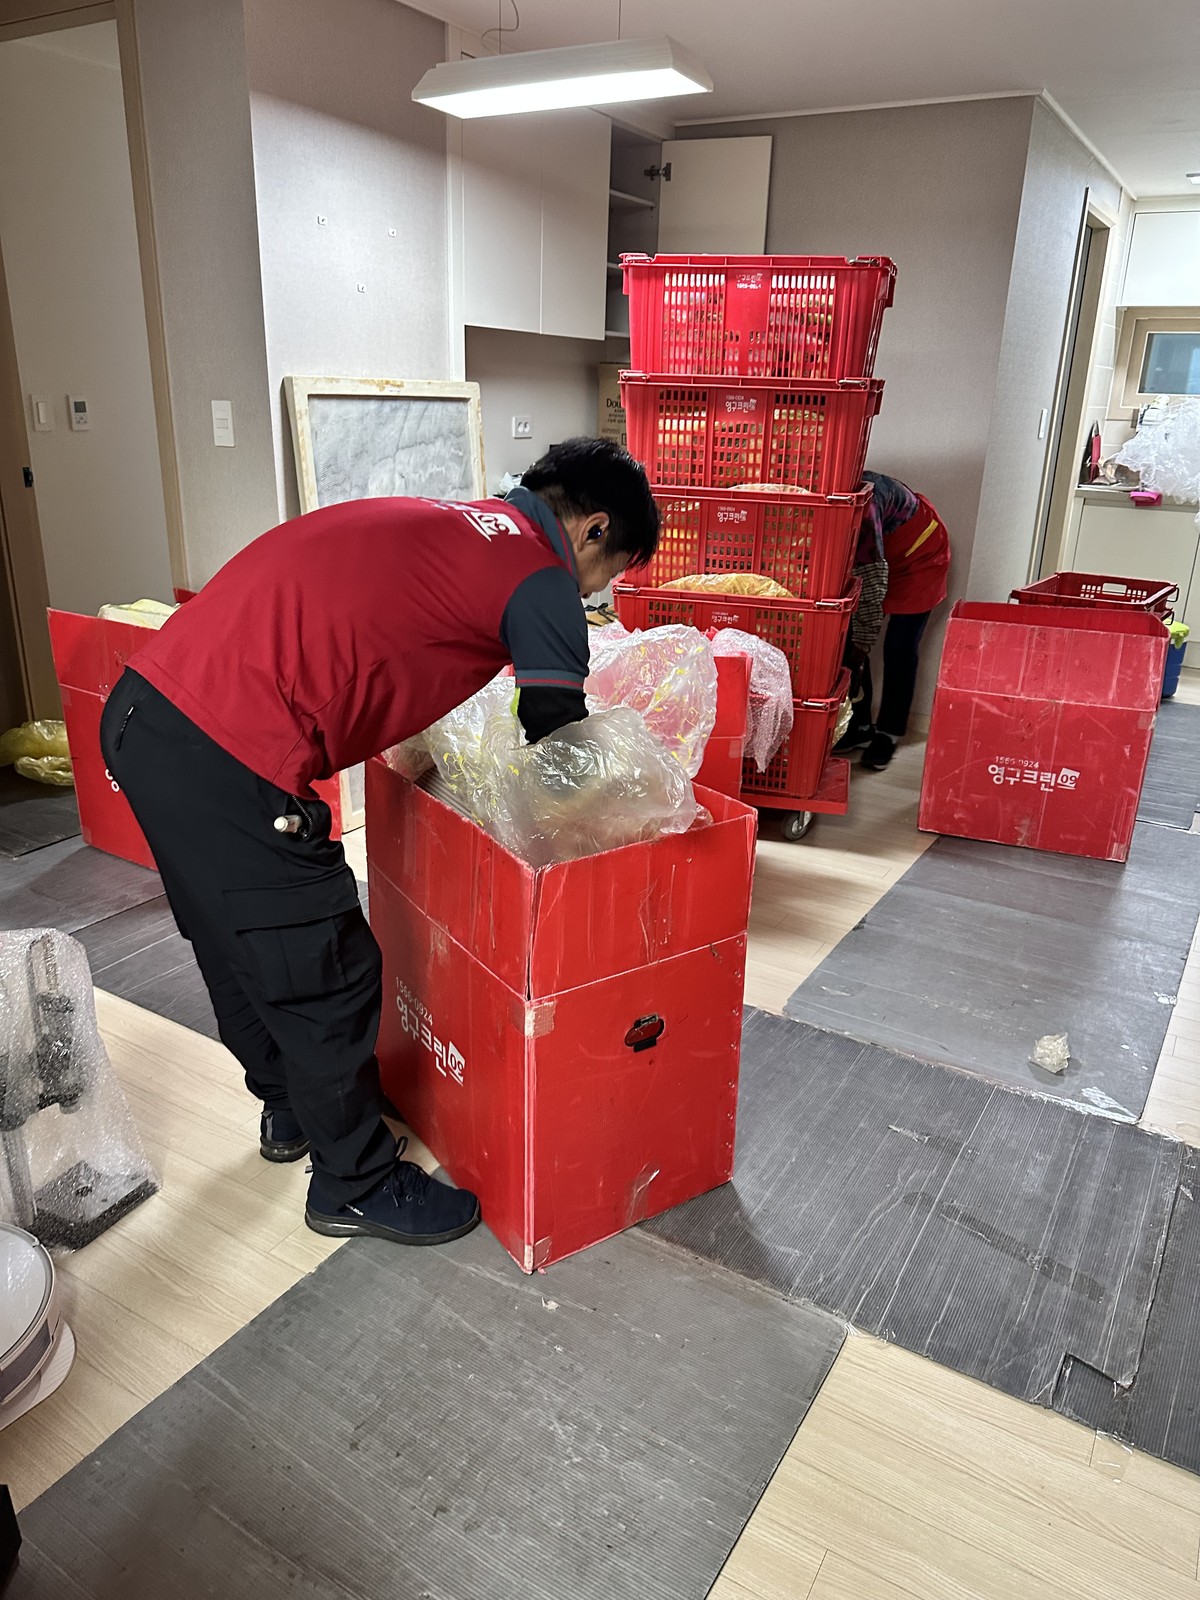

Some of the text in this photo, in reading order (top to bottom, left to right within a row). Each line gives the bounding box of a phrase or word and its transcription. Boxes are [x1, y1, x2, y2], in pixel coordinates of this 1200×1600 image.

[717, 511, 740, 524] 영구크린
[995, 756, 1039, 769] 15660924
[988, 764, 1056, 792] 영구크린
[395, 976, 433, 1026] 1566-0924
[396, 994, 447, 1078] 영구크린
